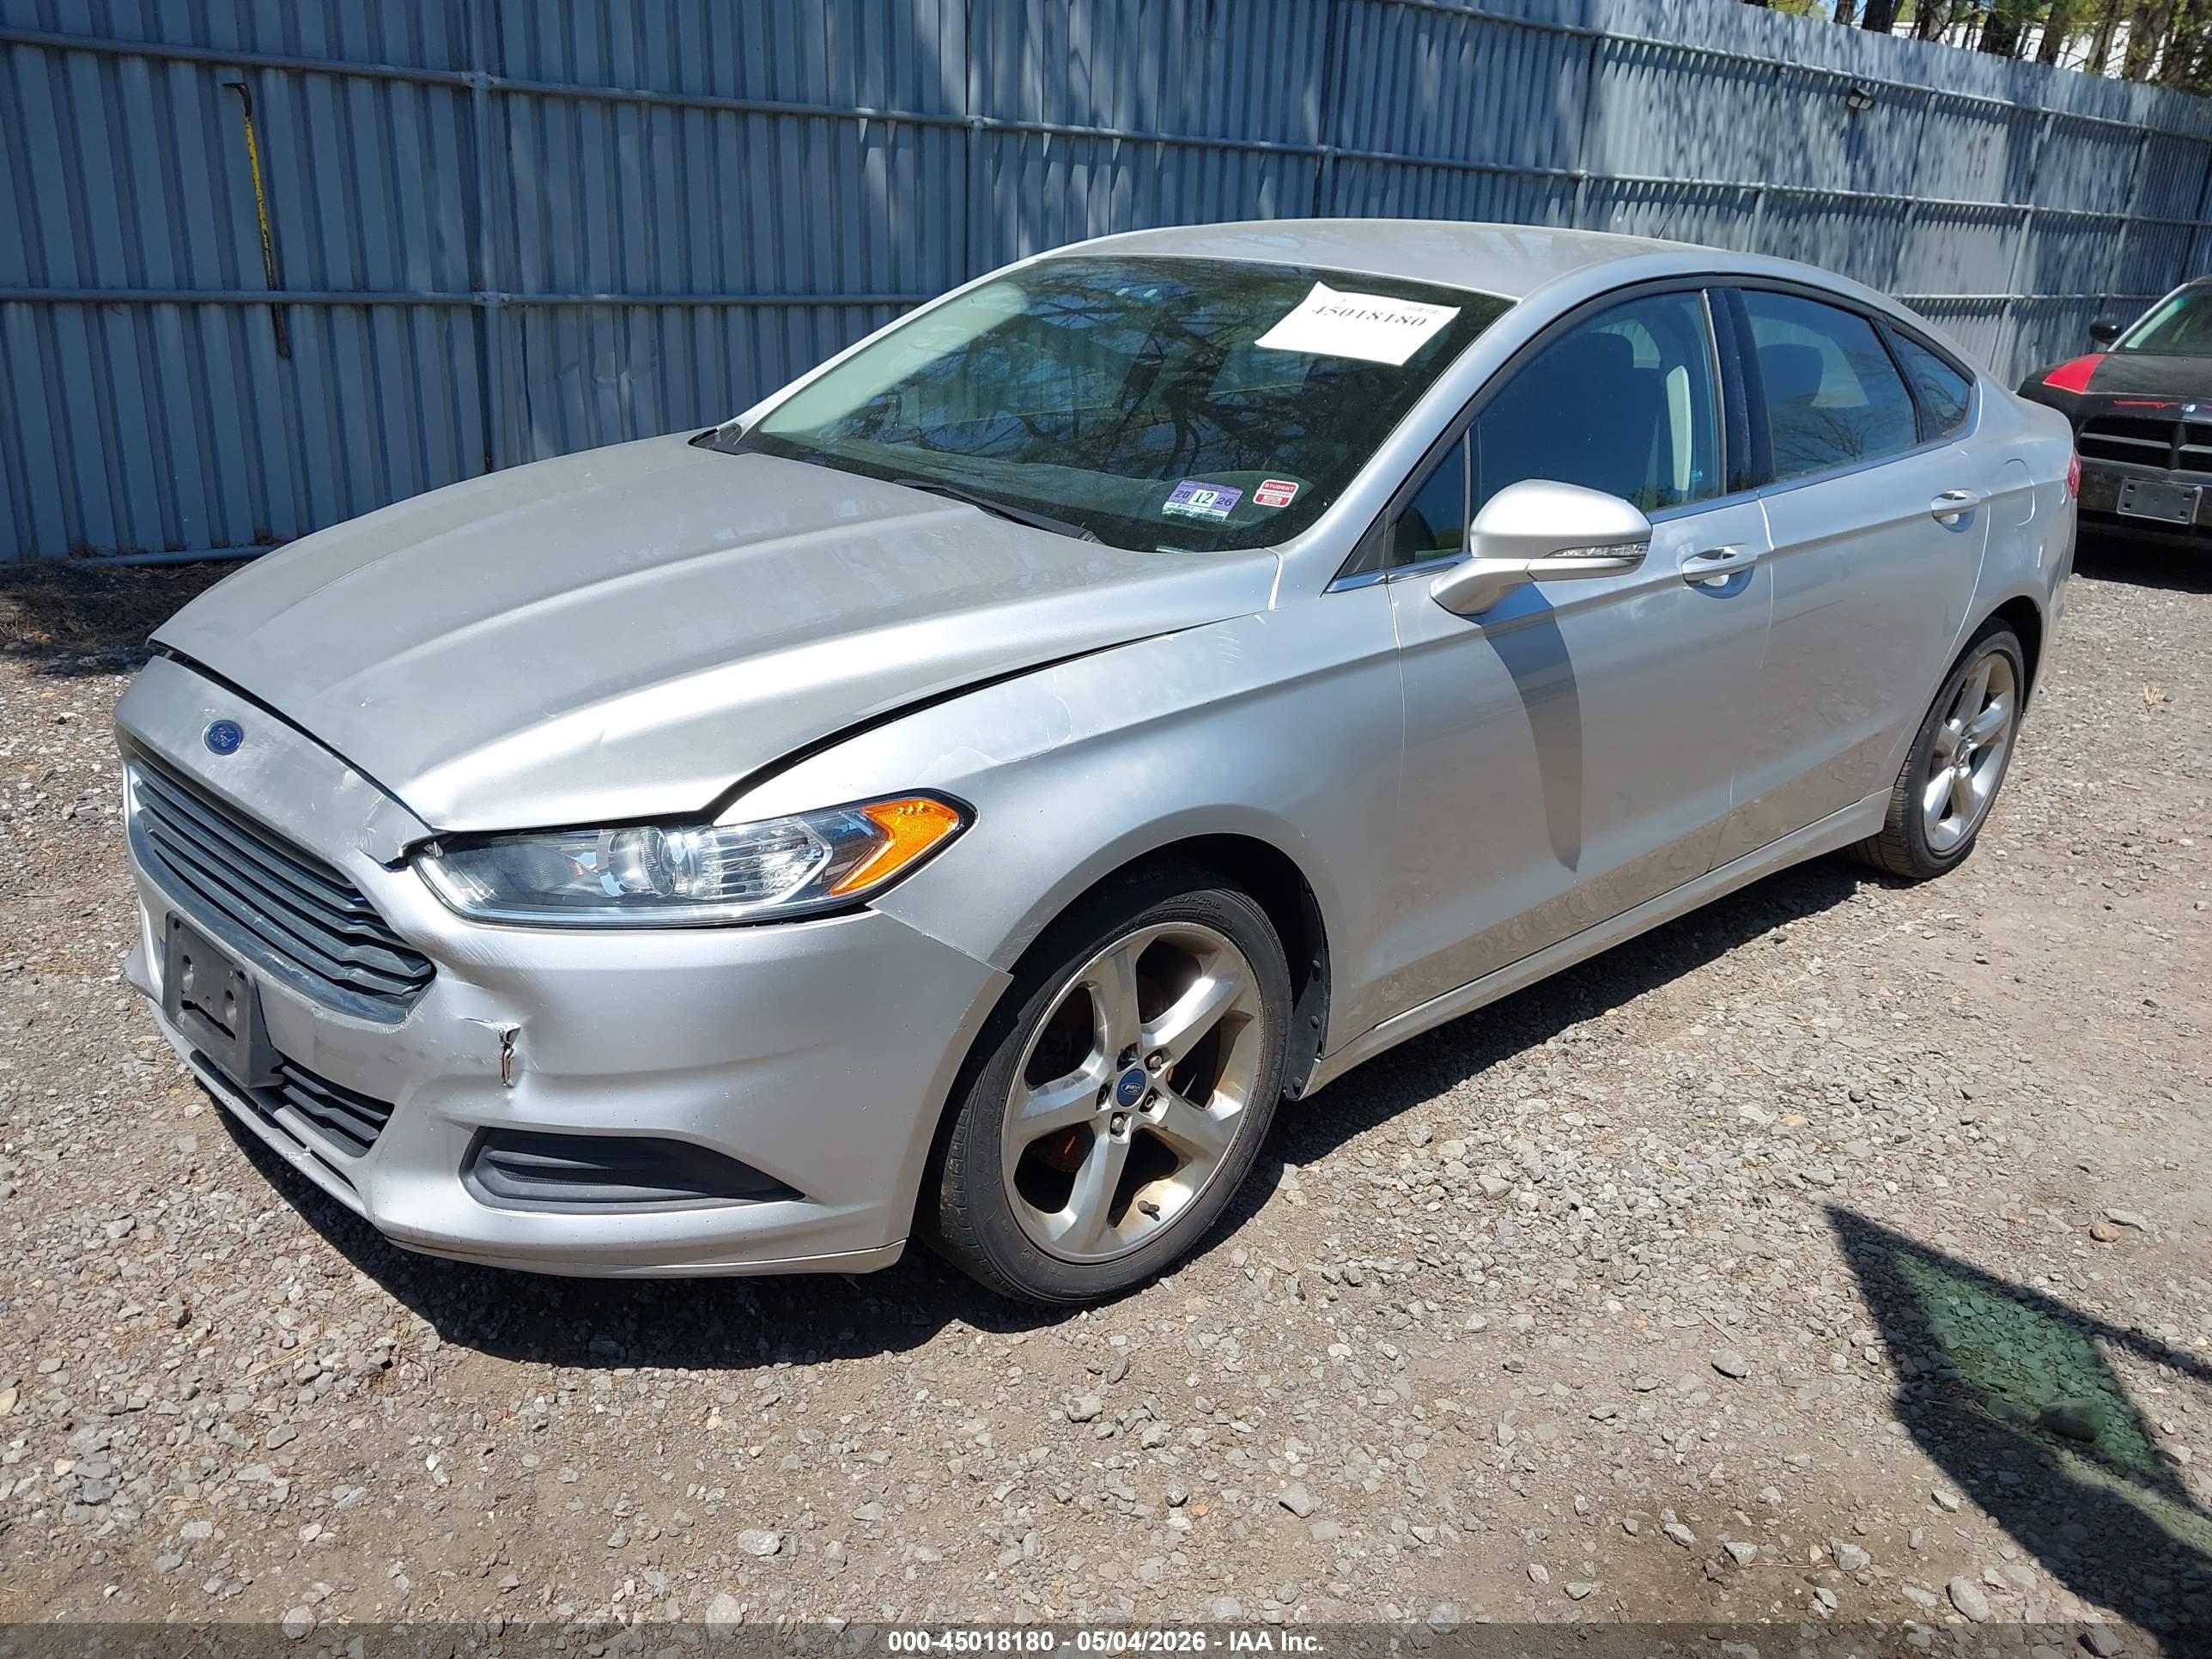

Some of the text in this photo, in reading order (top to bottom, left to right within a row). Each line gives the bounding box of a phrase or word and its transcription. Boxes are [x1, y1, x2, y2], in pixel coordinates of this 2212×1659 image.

[1311, 304, 1428, 327] 45018180
[1264, 482, 1295, 491] STUDENT
[1174, 489, 1234, 507] 20 12 26
